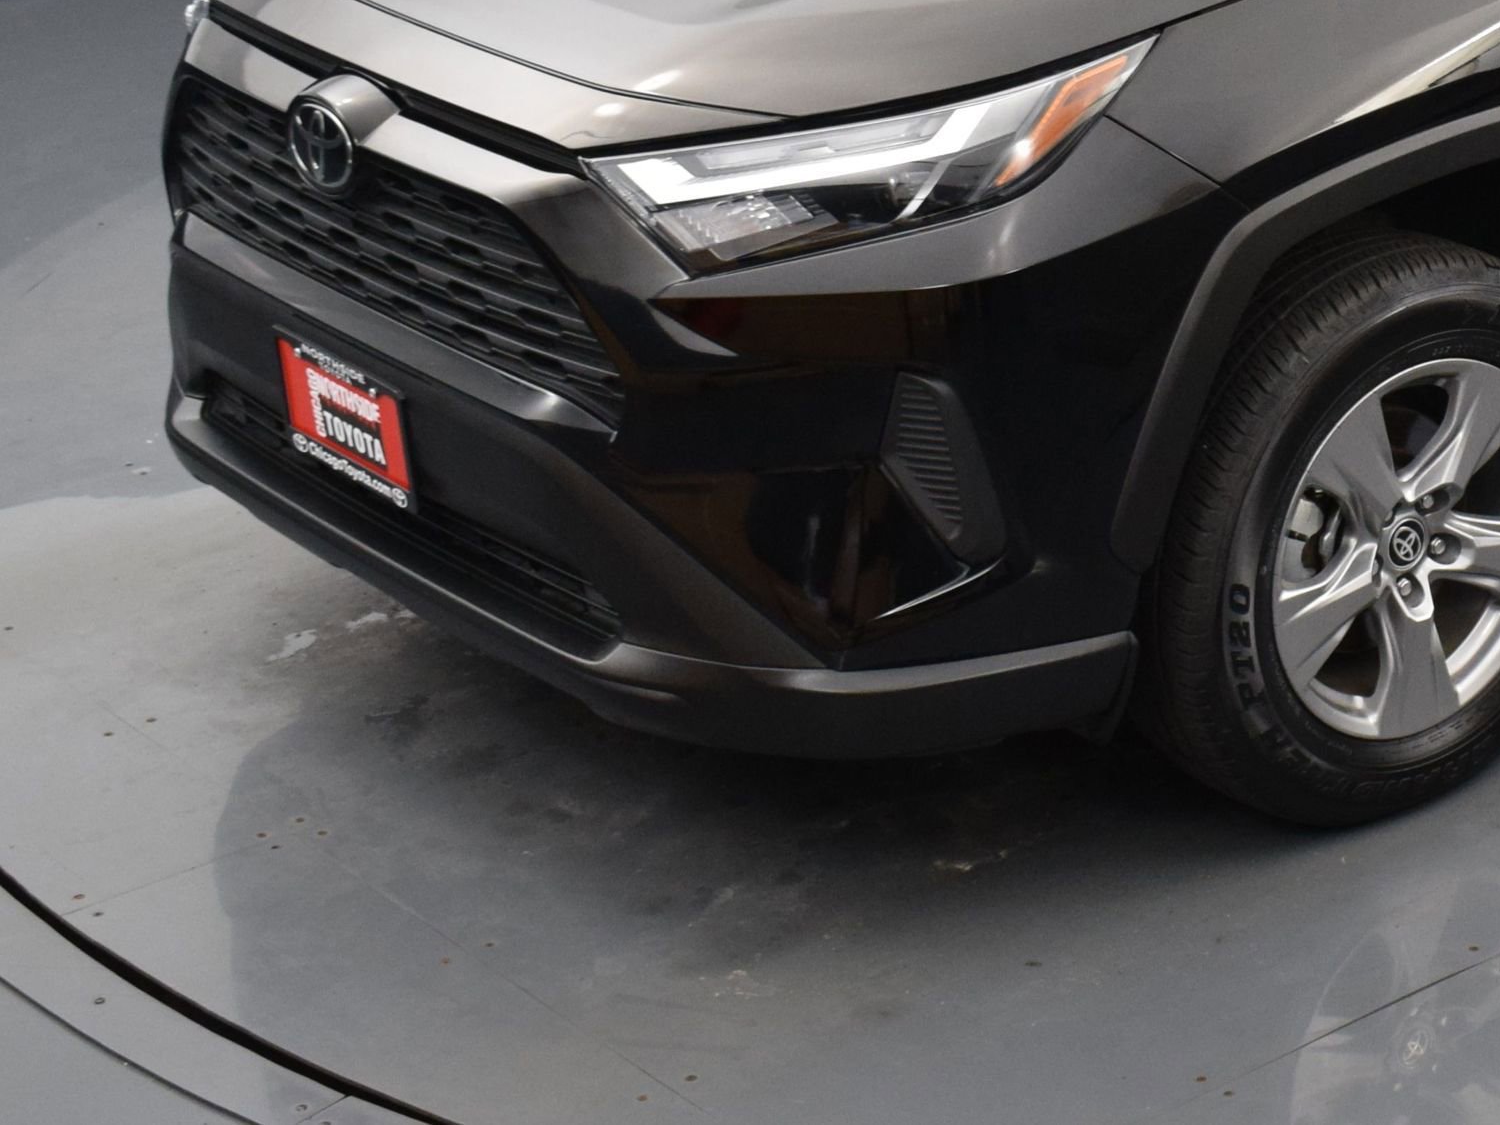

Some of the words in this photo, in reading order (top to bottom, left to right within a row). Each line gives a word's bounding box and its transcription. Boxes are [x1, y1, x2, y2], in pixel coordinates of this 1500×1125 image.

[317, 372, 382, 425] NORTHSIDE
[323, 410, 387, 465] TOYOTA
[1228, 582, 1264, 712] PT20
